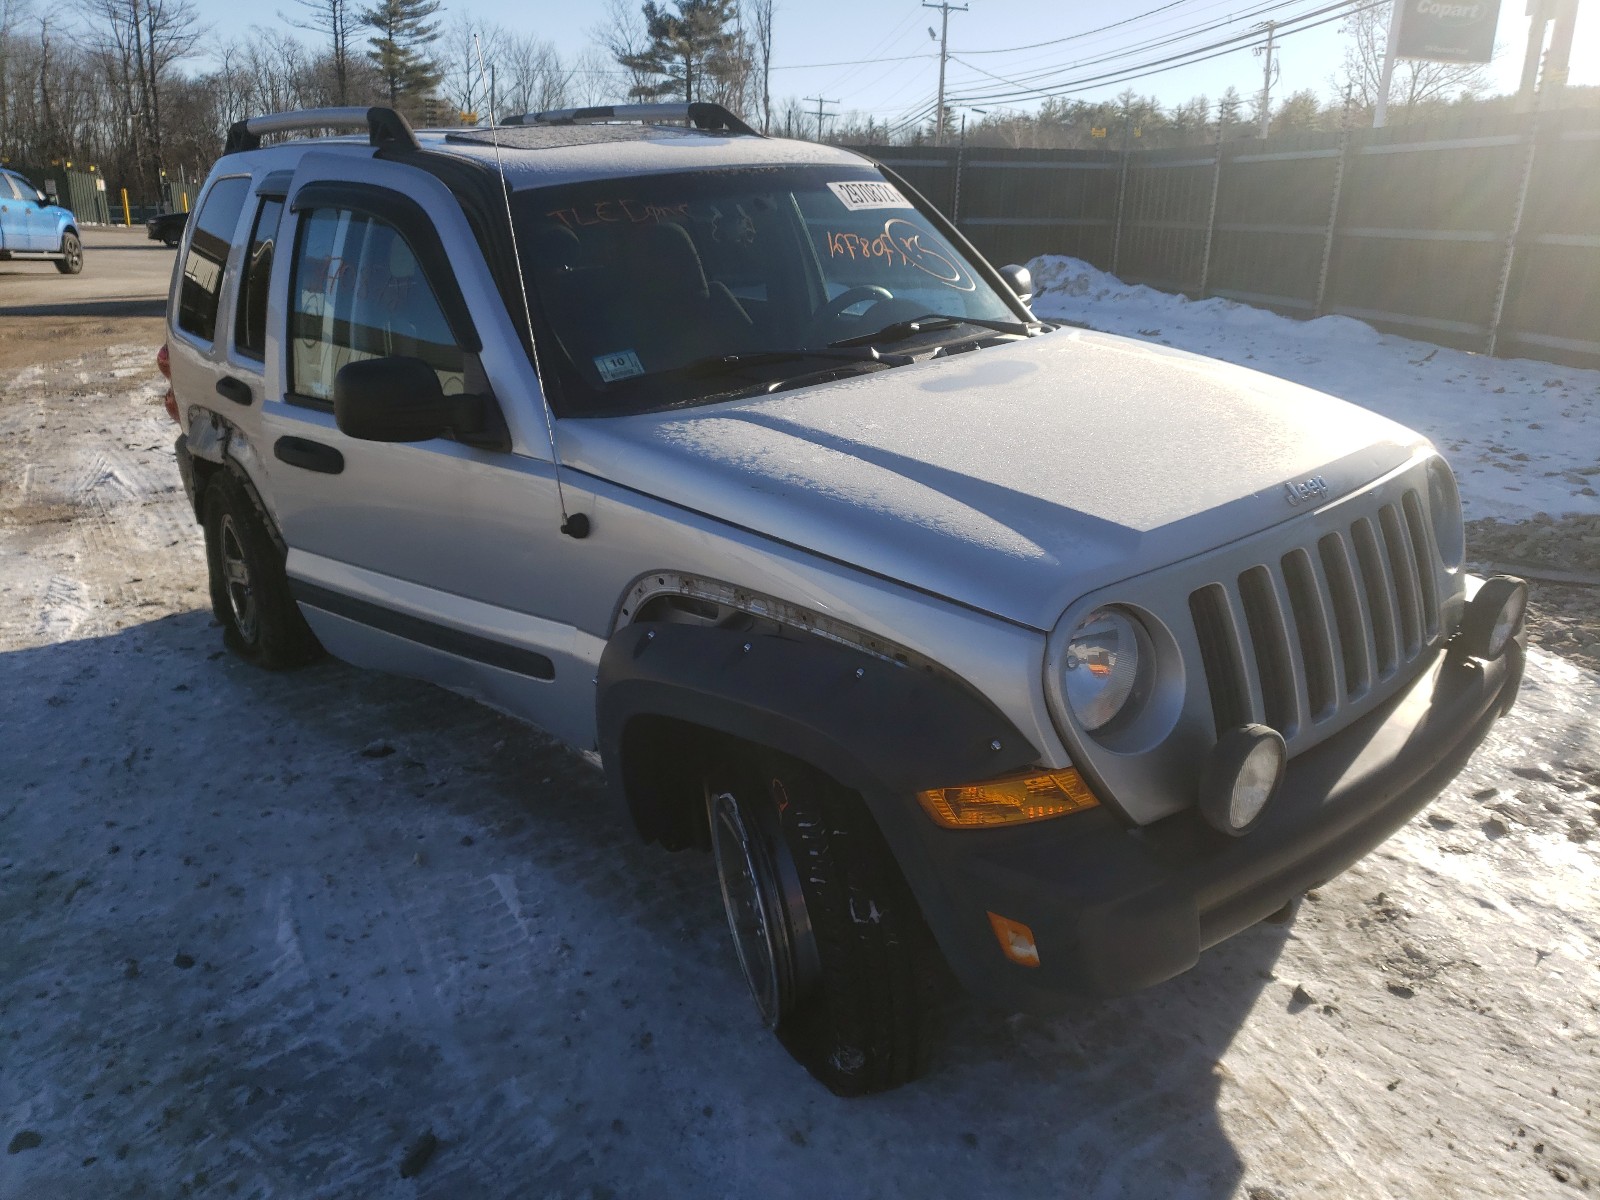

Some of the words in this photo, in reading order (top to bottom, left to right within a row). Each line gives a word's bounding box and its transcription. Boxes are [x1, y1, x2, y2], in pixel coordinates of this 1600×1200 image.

[1416, 0, 1480, 18] Copart
[838, 183, 901, 203] 29708721
[610, 357, 626, 368] 10
[1285, 475, 1328, 506] Jeep
